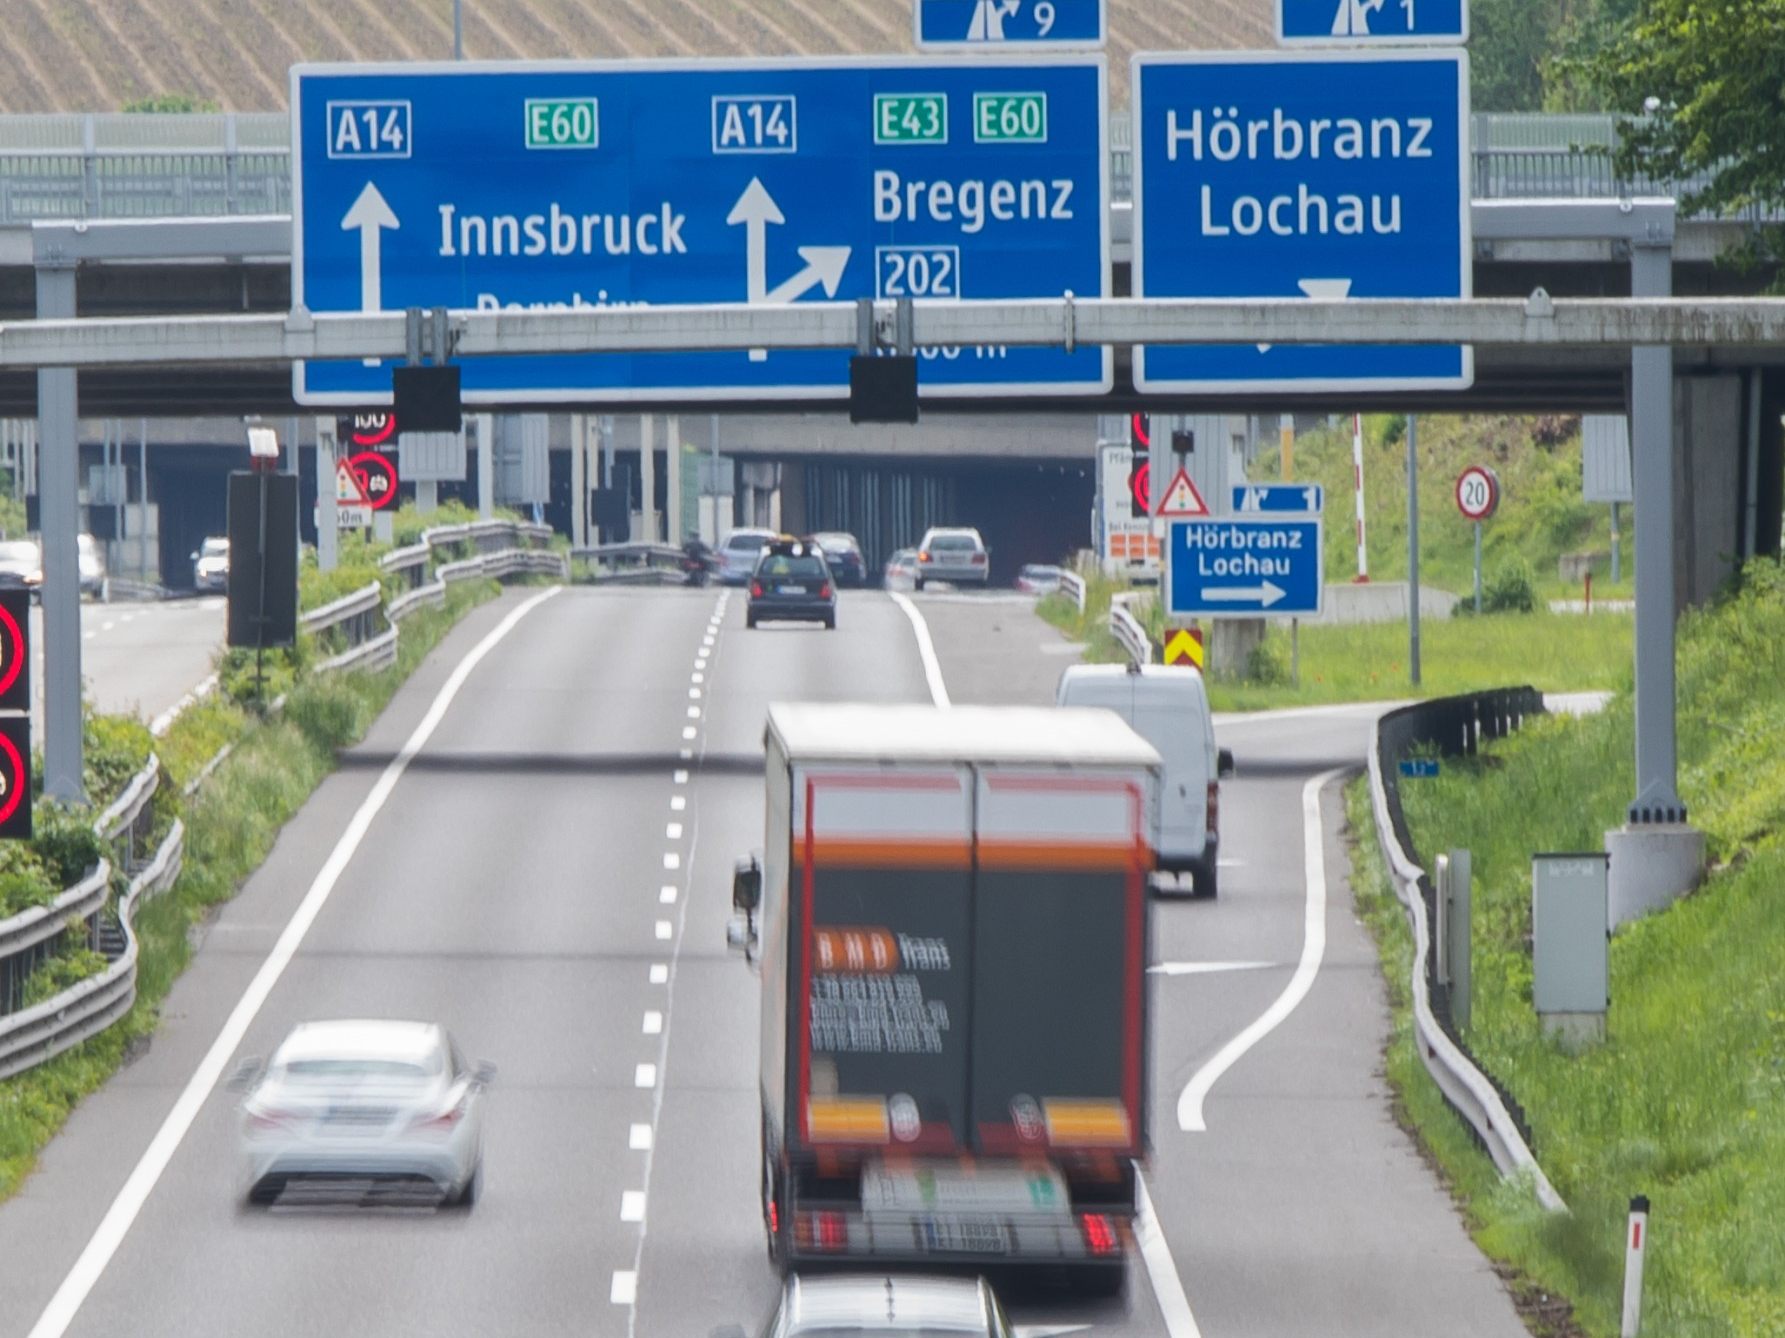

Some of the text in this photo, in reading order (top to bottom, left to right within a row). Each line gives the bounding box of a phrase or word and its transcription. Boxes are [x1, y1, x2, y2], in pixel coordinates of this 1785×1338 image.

[1034, 1, 1055, 36] 9
[335, 108, 403, 151] A14
[531, 105, 592, 143] E60
[720, 103, 788, 146] A14
[881, 98, 1040, 138] E43 E60
[1167, 106, 1433, 161] Hörbranz
[874, 169, 1074, 233] Bregenz
[1201, 183, 1401, 236] Lochau
[438, 201, 687, 256] Innsbruck
[885, 253, 951, 295] 202
[1302, 488, 1316, 511] 1
[1466, 481, 1484, 505] 20
[1186, 525, 1302, 549] Hörbranz
[1199, 552, 1290, 576] Lochau
